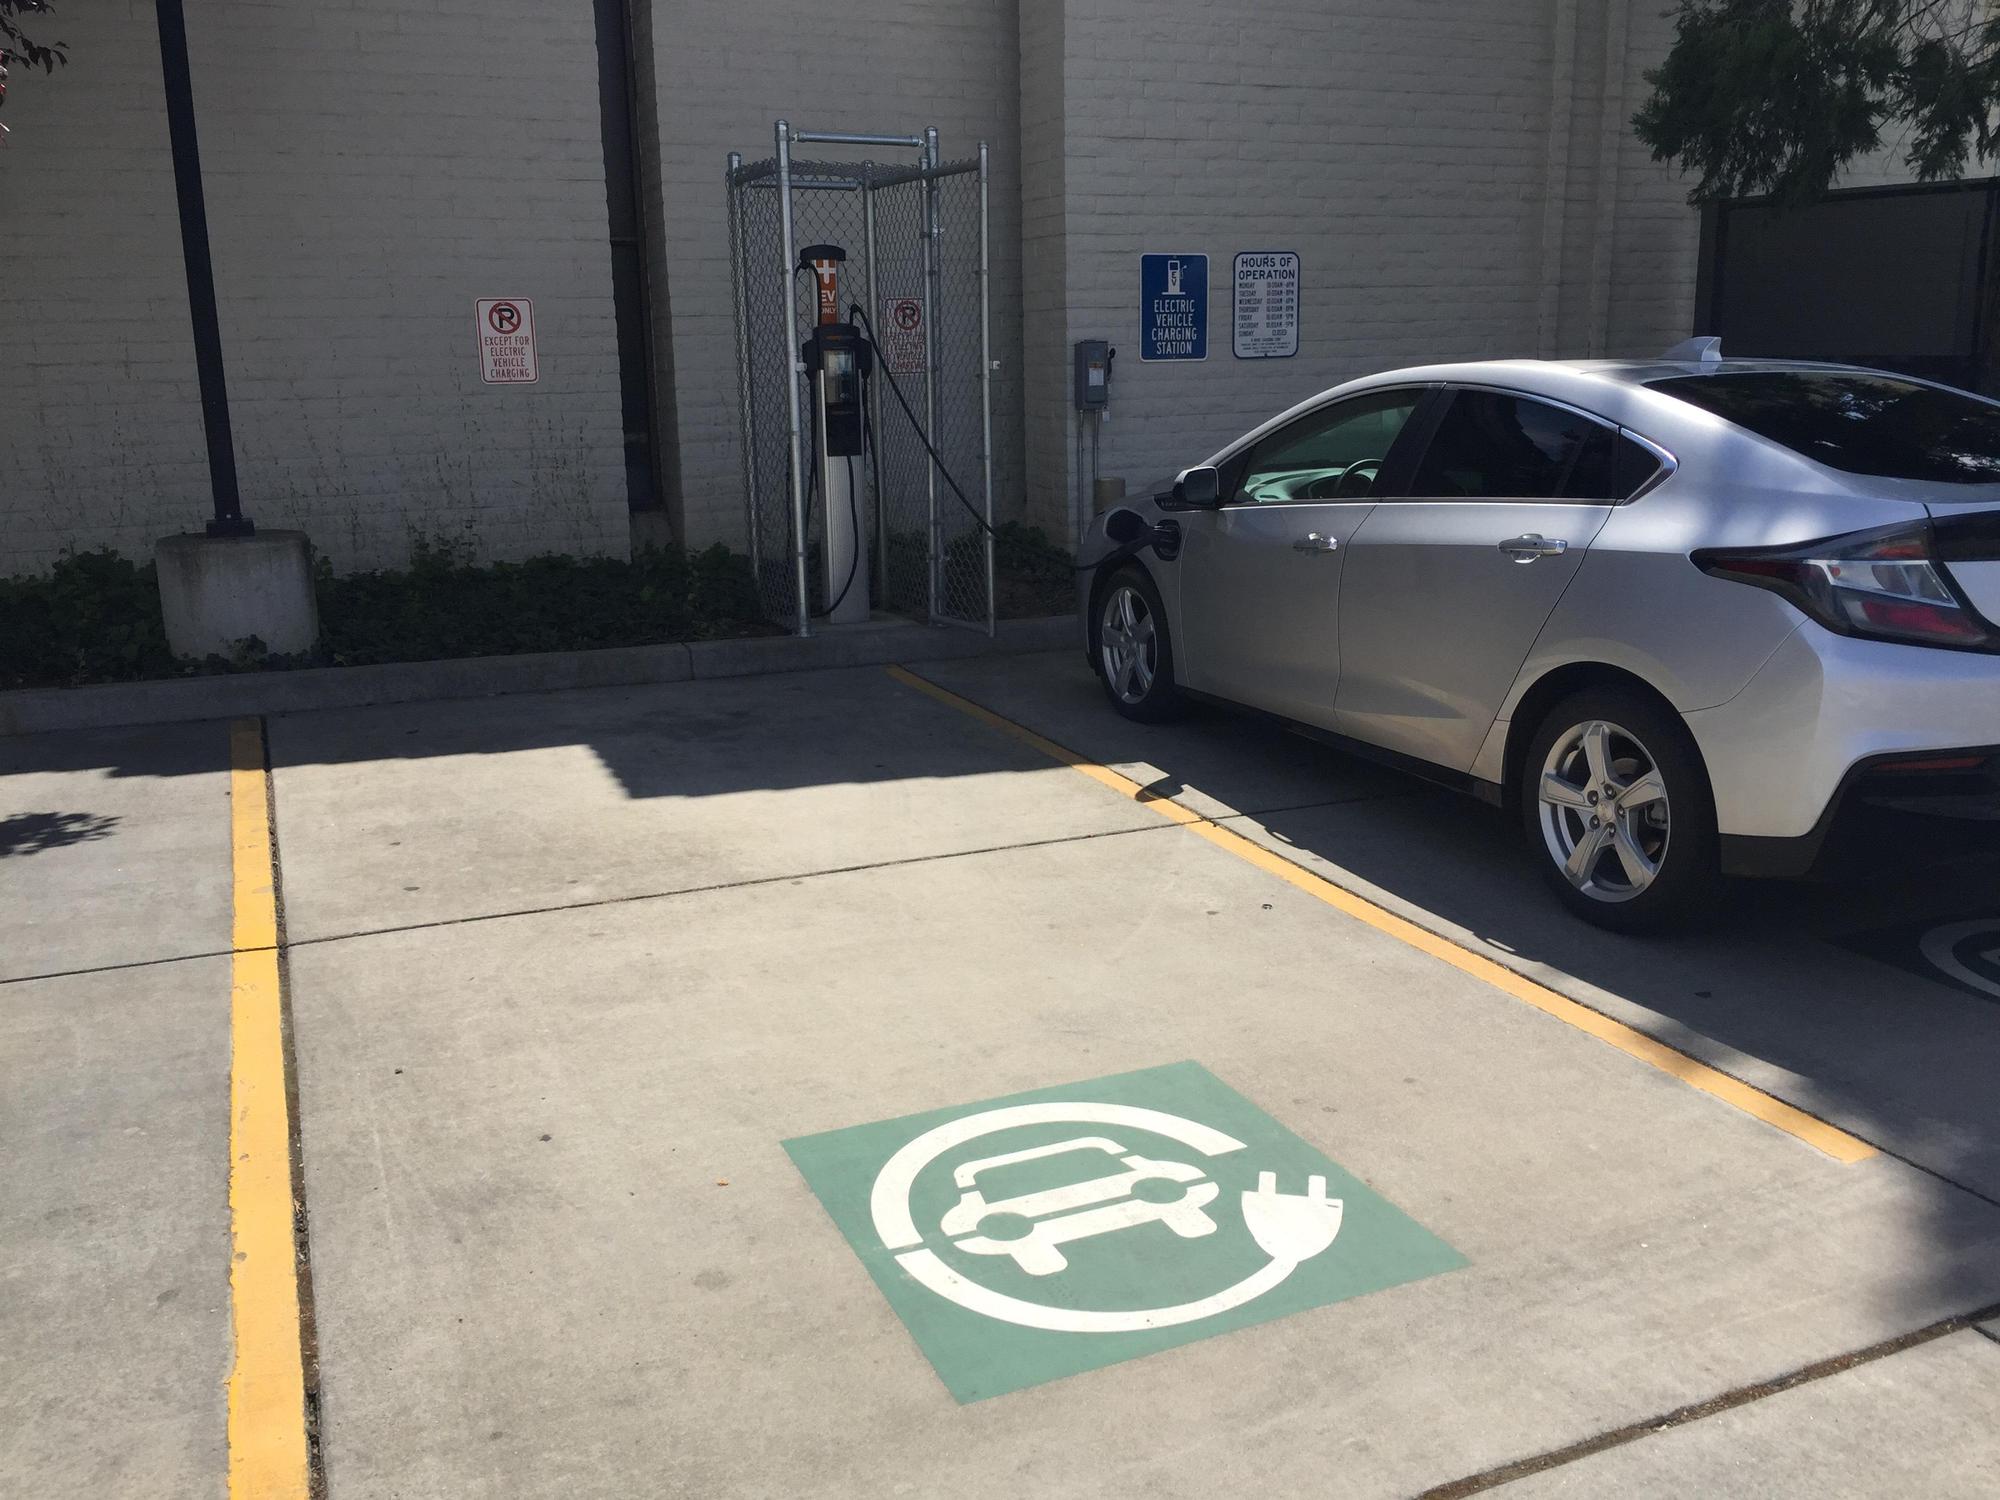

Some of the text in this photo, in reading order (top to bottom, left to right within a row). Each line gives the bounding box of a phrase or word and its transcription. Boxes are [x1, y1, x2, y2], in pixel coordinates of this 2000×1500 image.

[1241, 257, 1293, 268] HOURS OF
[1238, 269, 1295, 280] OPERATION
[1154, 300, 1195, 313] ELECTRIC
[1156, 313, 1193, 326] VEHICLE
[1151, 327, 1197, 340] CHARGING
[485, 336, 529, 346] EXCEPT FOR
[490, 347, 526, 356] ELECTRIC
[1156, 341, 1192, 354] STATION
[493, 357, 525, 367] VEHICLE
[490, 368, 530, 378] CHARGING
